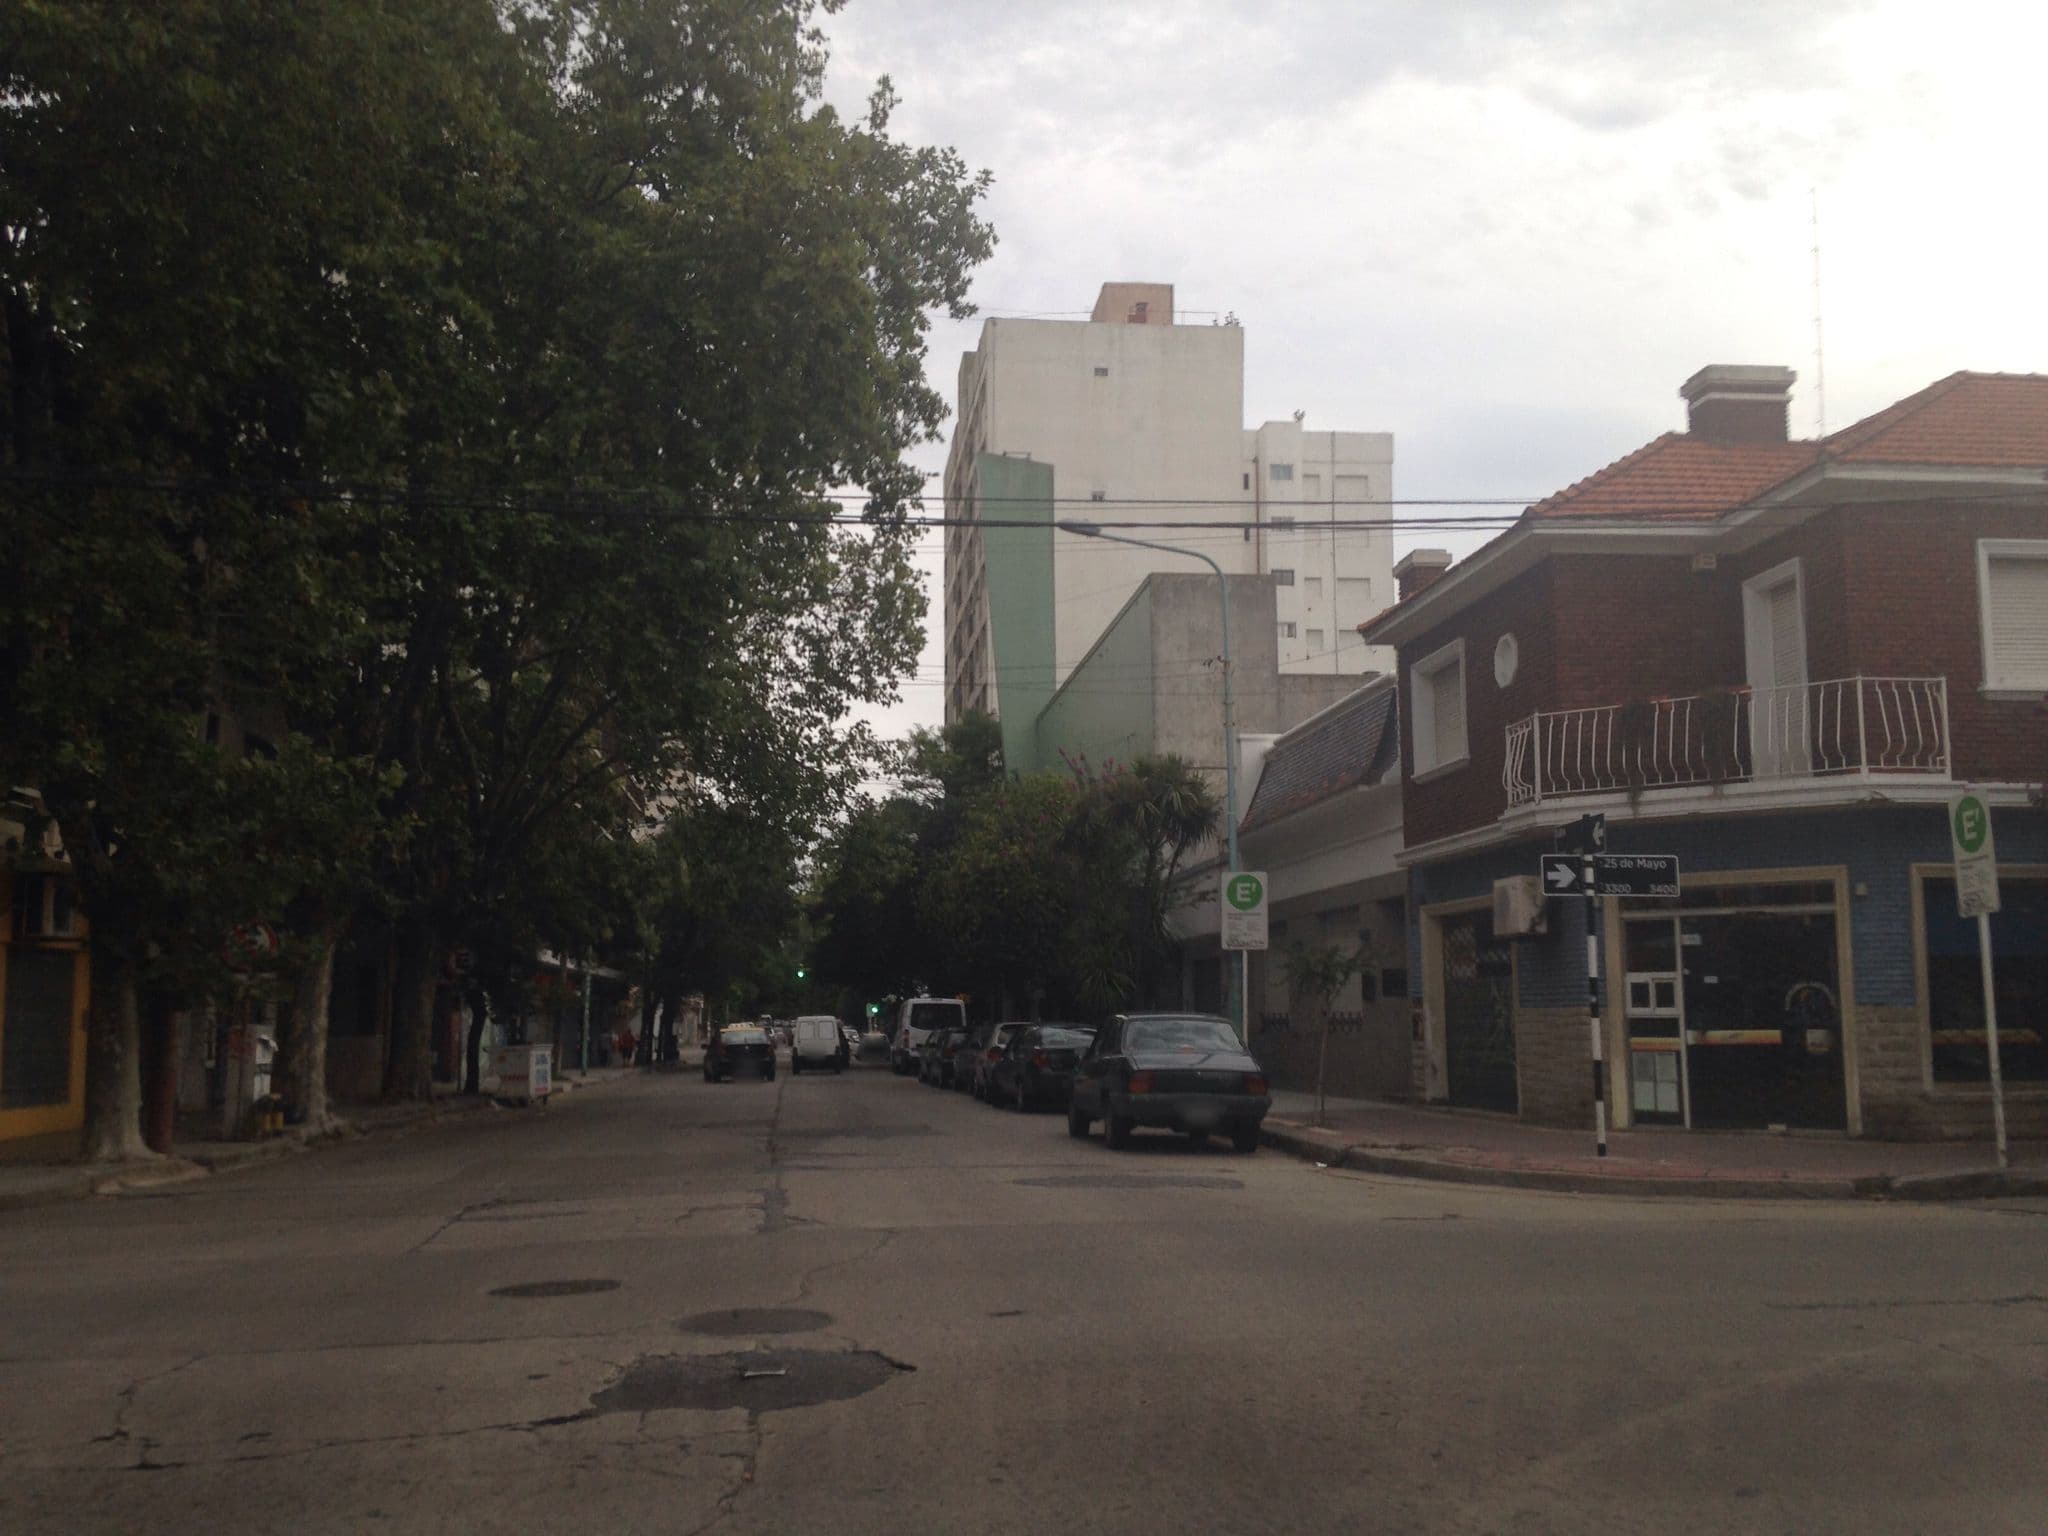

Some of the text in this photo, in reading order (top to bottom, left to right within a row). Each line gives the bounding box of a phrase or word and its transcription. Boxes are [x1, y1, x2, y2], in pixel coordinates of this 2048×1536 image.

[1603, 858, 1667, 870] 25 de Mayo
[1604, 884, 1678, 894] 3300 3400
